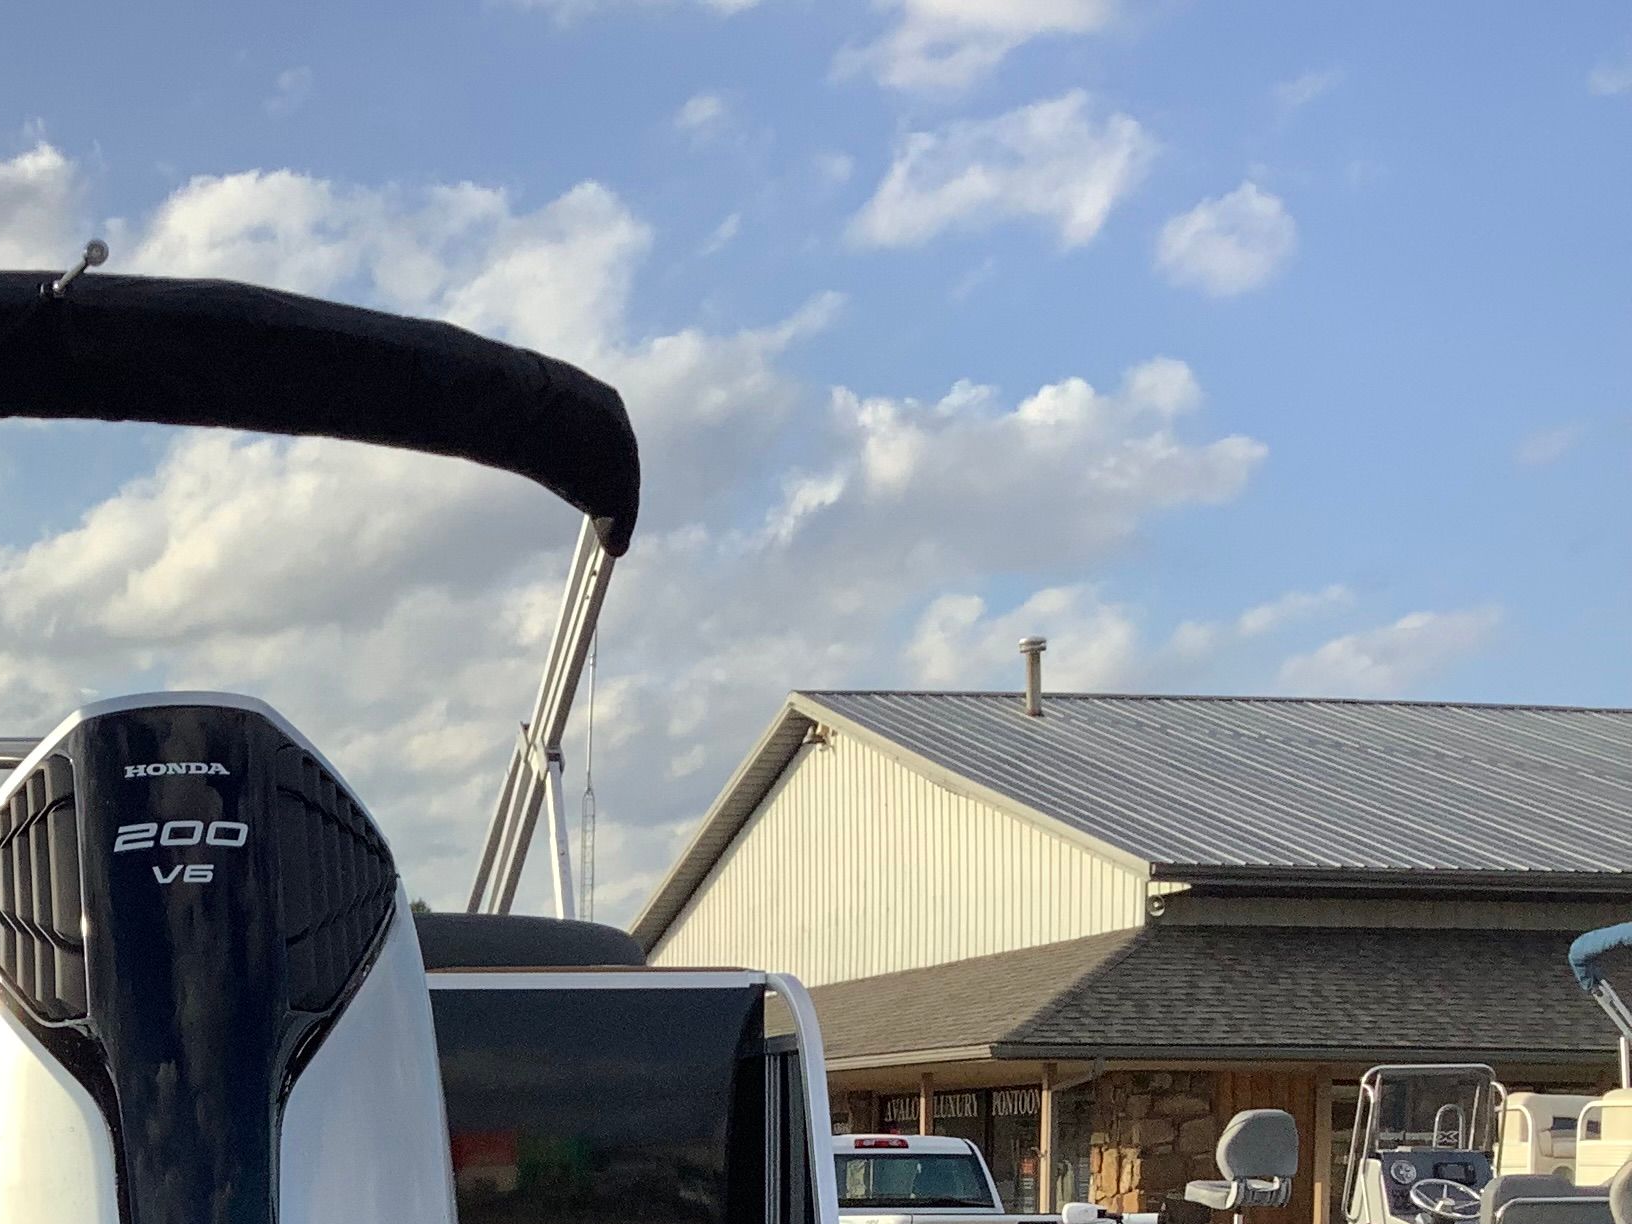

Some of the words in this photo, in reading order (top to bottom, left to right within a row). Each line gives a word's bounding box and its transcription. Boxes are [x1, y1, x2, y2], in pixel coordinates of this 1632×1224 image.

[124, 762, 230, 778] HONDA
[114, 820, 249, 853] 200
[152, 864, 214, 884] V6
[884, 1096, 921, 1122] AVALO
[933, 1093, 978, 1119] LUXURY
